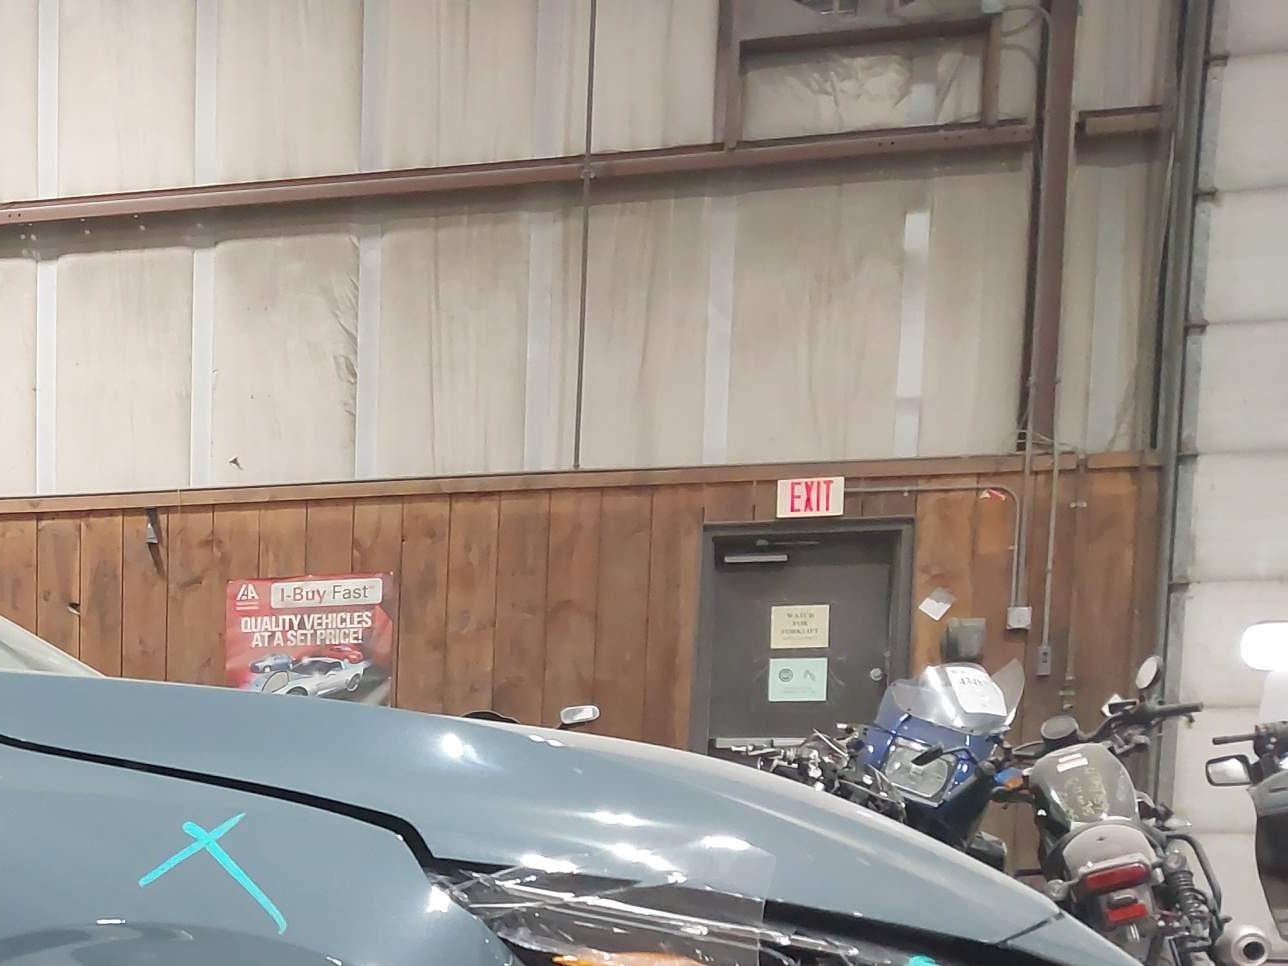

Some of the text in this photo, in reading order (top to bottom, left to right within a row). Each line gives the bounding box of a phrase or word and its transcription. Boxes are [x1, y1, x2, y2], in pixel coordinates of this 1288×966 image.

[790, 480, 833, 512] EXIT
[280, 585, 369, 603] I-Buy Fast
[241, 612, 372, 632] QUALITY VEHICLES
[252, 628, 363, 648] AT A SET PRICE!
